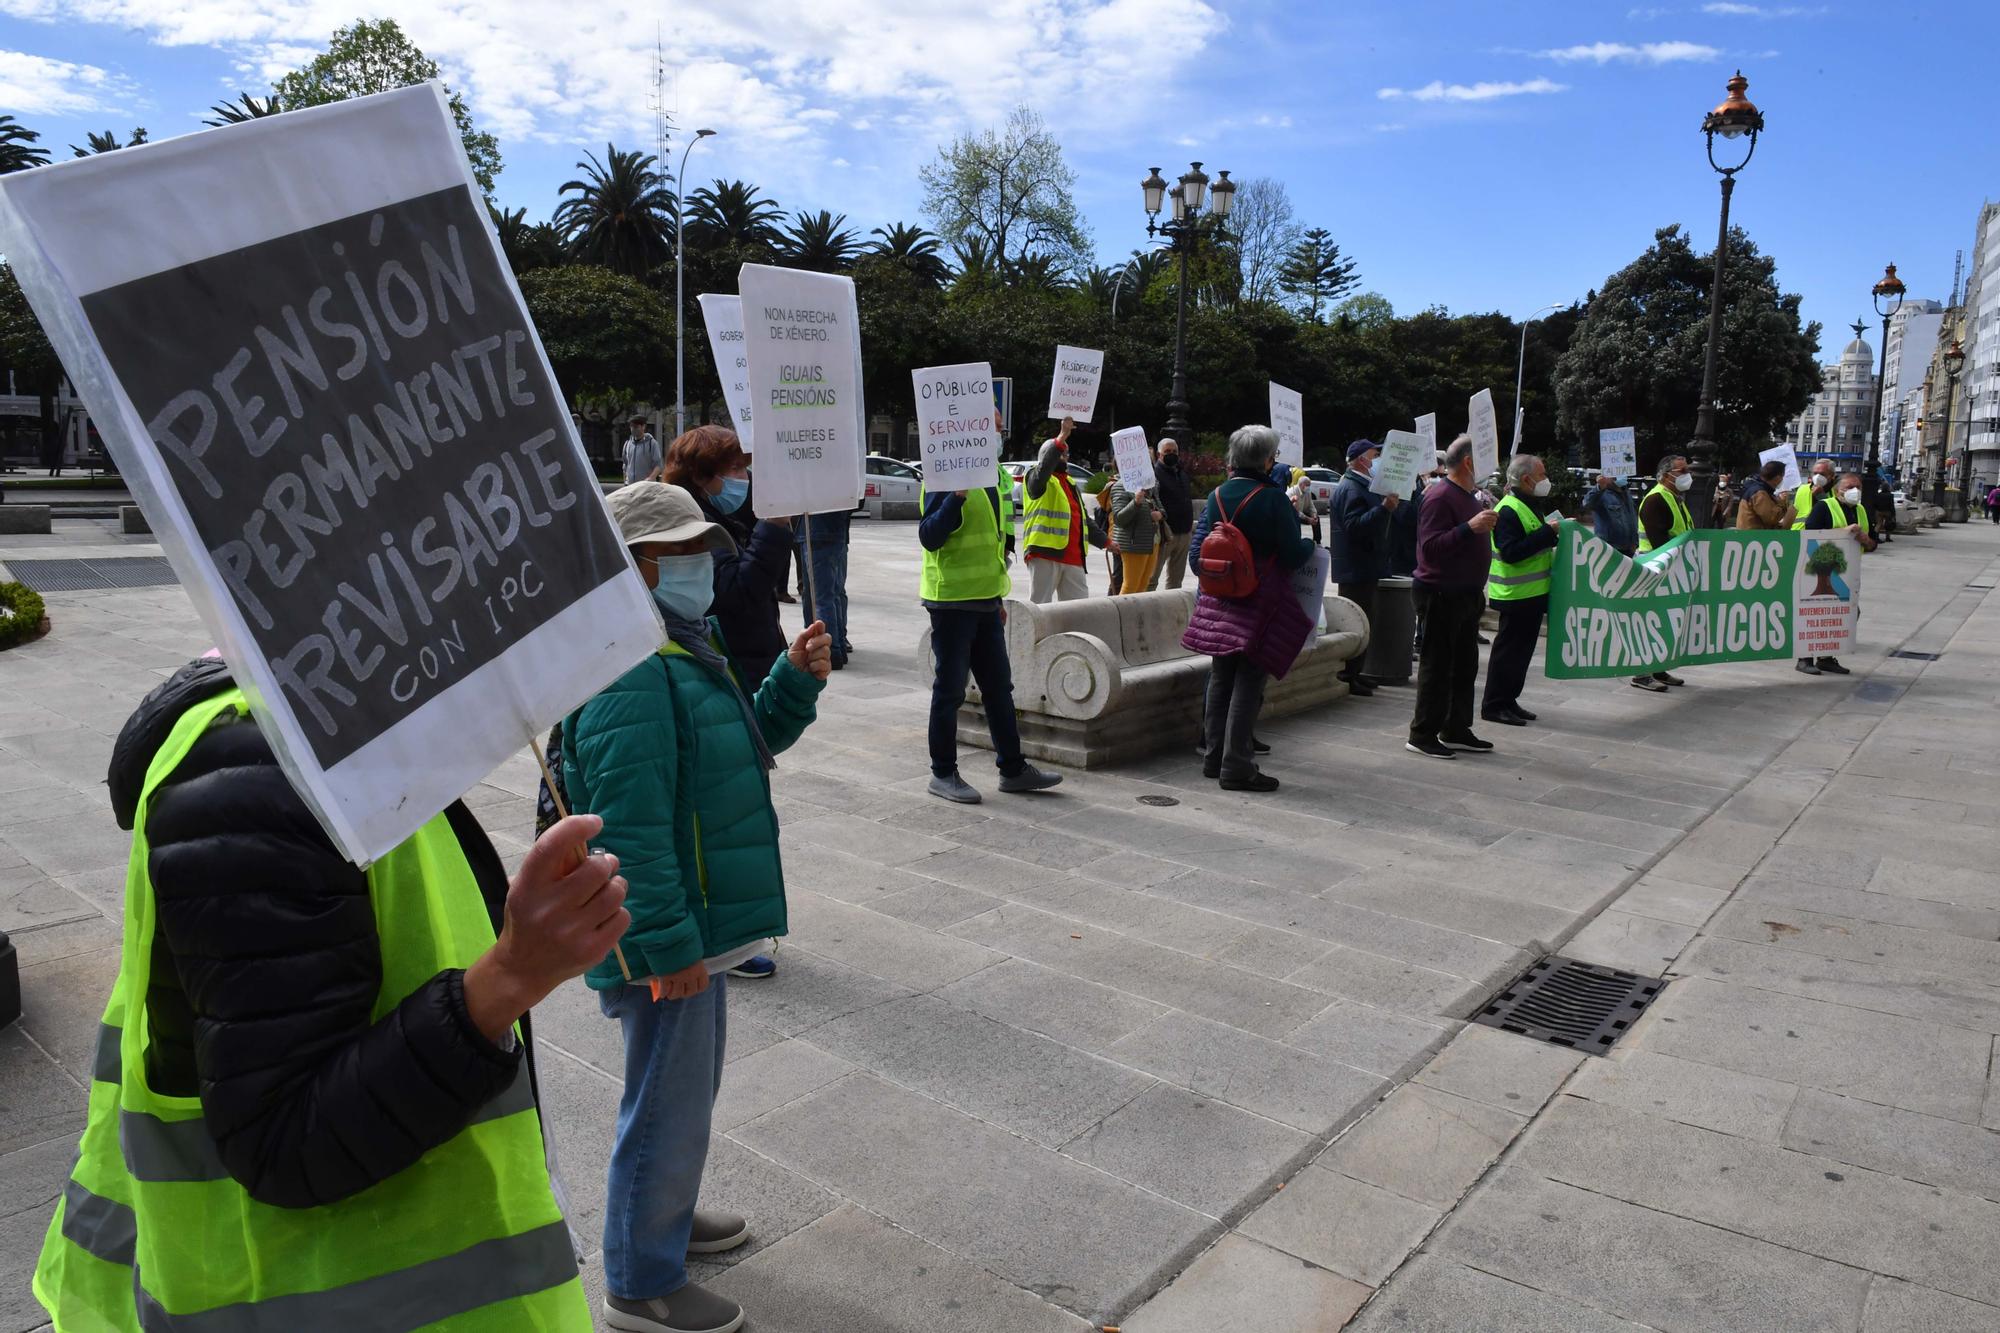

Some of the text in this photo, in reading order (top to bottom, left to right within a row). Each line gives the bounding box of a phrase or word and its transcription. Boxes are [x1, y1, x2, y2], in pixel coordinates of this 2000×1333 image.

[764, 307, 838, 325] NON A BRECHA
[770, 325, 830, 342] DE XÉNERO.
[147, 213, 478, 499] PENSIÓN
[779, 364, 823, 382] IGUAIS
[771, 386, 836, 406] PENSIÓNS
[921, 383, 932, 400] O
[776, 428, 836, 443] MULLERES E
[929, 417, 990, 436] SERVICIO
[788, 446, 823, 461] HOMES
[927, 437, 988, 454] O PRIVADO
[934, 457, 990, 473] BENEFICIO
[211, 329, 536, 629] PERMANENTE
[1572, 530, 1633, 598] POLA
[1721, 540, 1784, 591] DOS
[270, 428, 577, 736] REVISABLE
[390, 560, 545, 702] CON IPC
[1562, 606, 1668, 667] SERVIZOS
